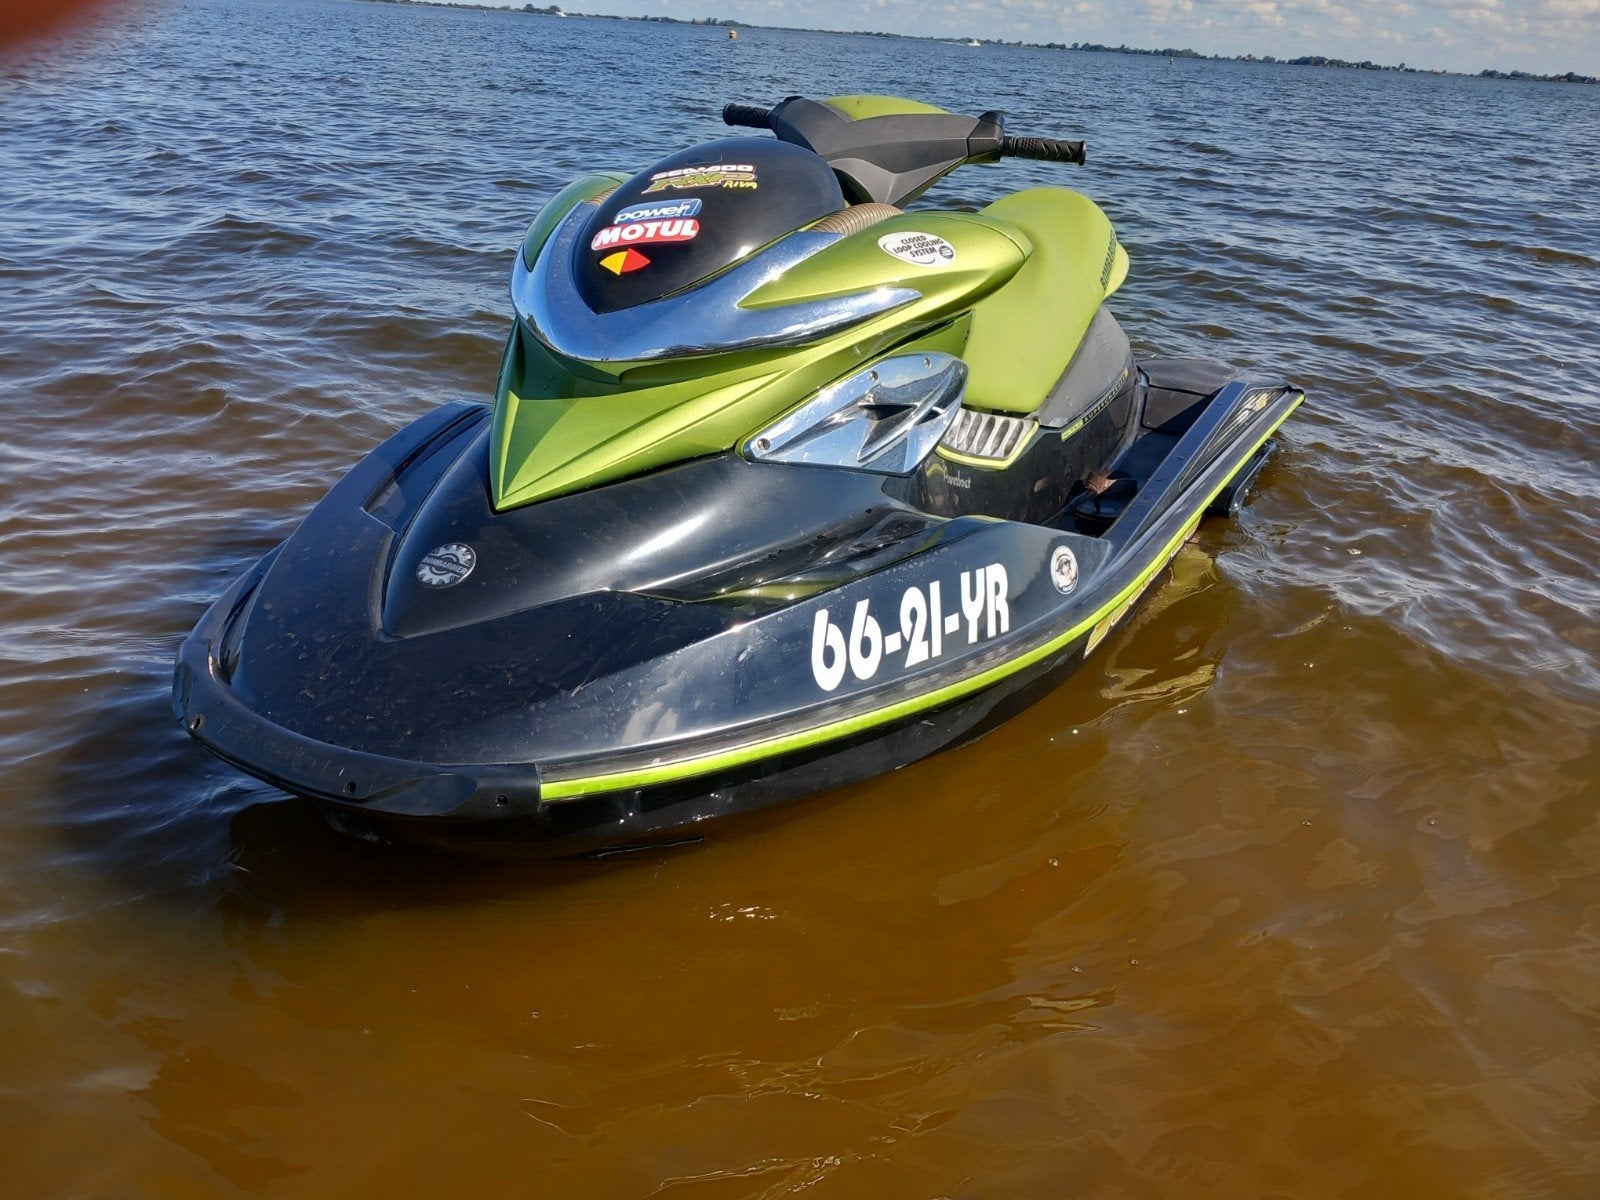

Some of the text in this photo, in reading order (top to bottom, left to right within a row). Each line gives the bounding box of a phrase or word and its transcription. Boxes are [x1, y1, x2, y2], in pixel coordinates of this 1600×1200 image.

[592, 219, 698, 249] MOTUL
[901, 235, 926, 244] CLOSED
[893, 238, 944, 253] LOOP COOLING
[910, 246, 937, 257] SYSTEM
[422, 556, 468, 575] BOMBARDIER
[811, 562, 1010, 692] 66-21-YR
